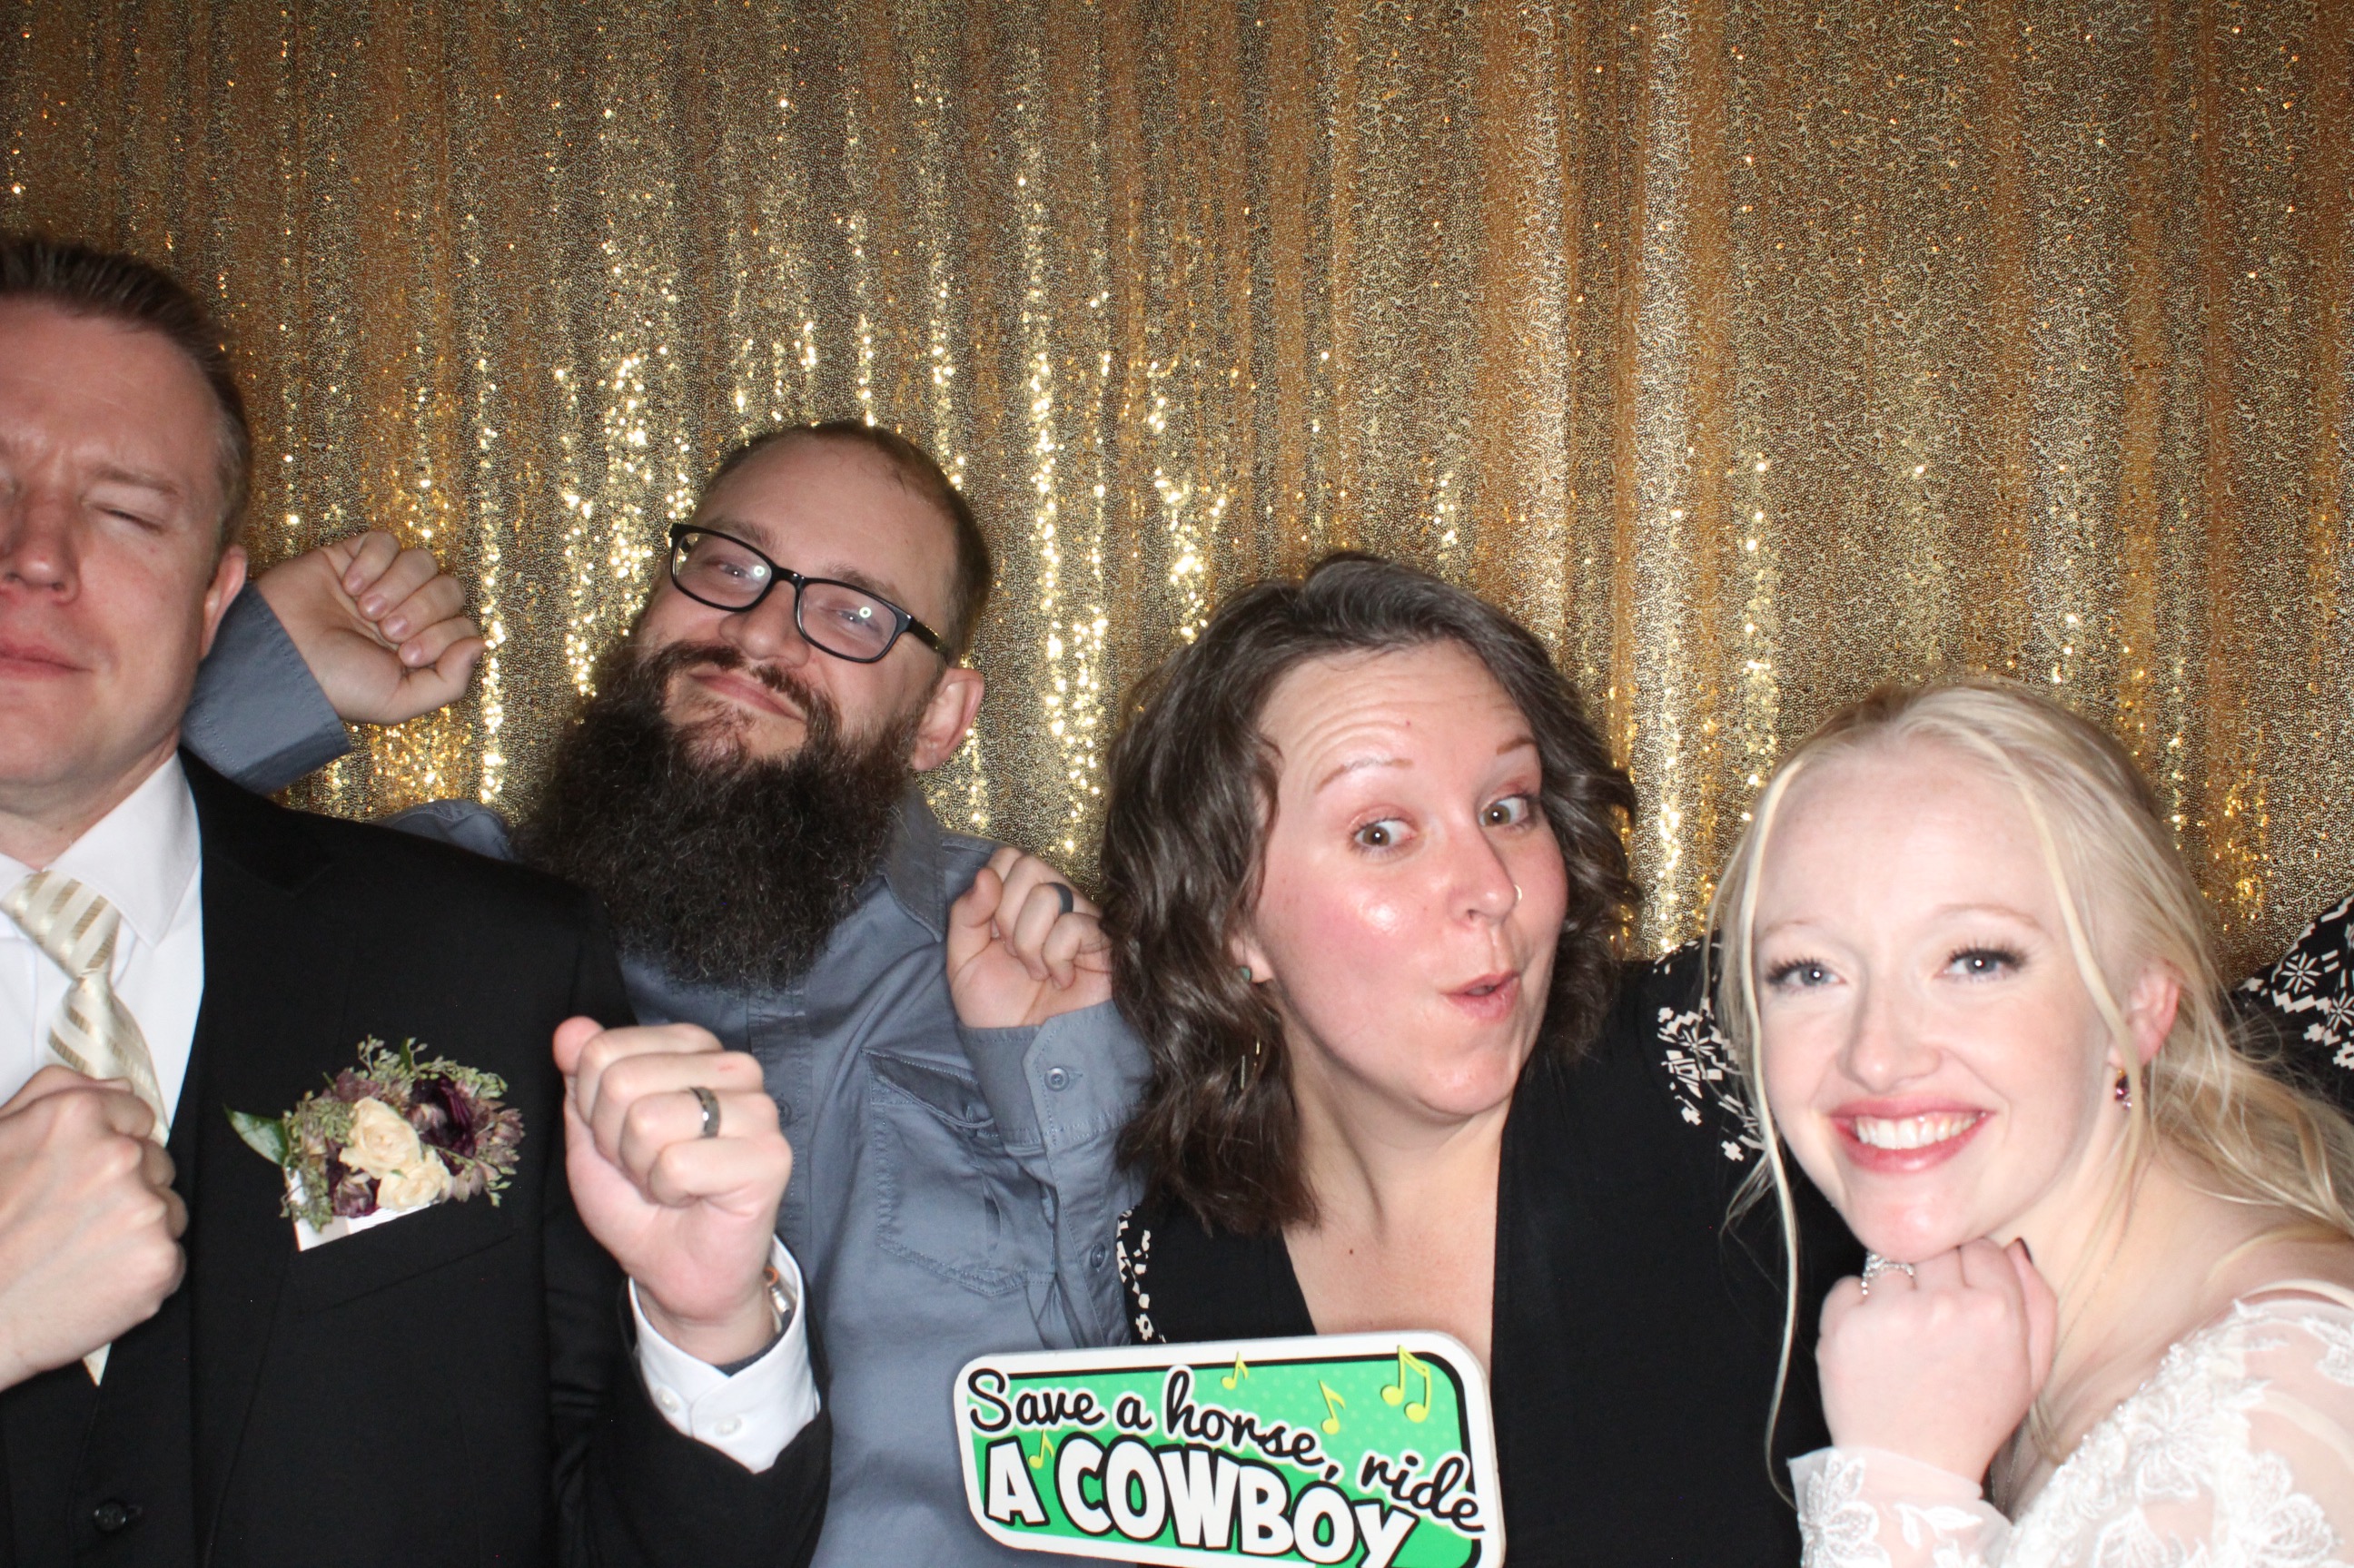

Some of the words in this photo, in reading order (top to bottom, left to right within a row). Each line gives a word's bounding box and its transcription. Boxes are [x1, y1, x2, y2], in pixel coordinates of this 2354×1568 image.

[967, 1368, 1103, 1431] Save
[1116, 1394, 1152, 1430] a
[1166, 1368, 1339, 1480] horse,
[1360, 1455, 1485, 1533] ride
[984, 1435, 1048, 1525] A
